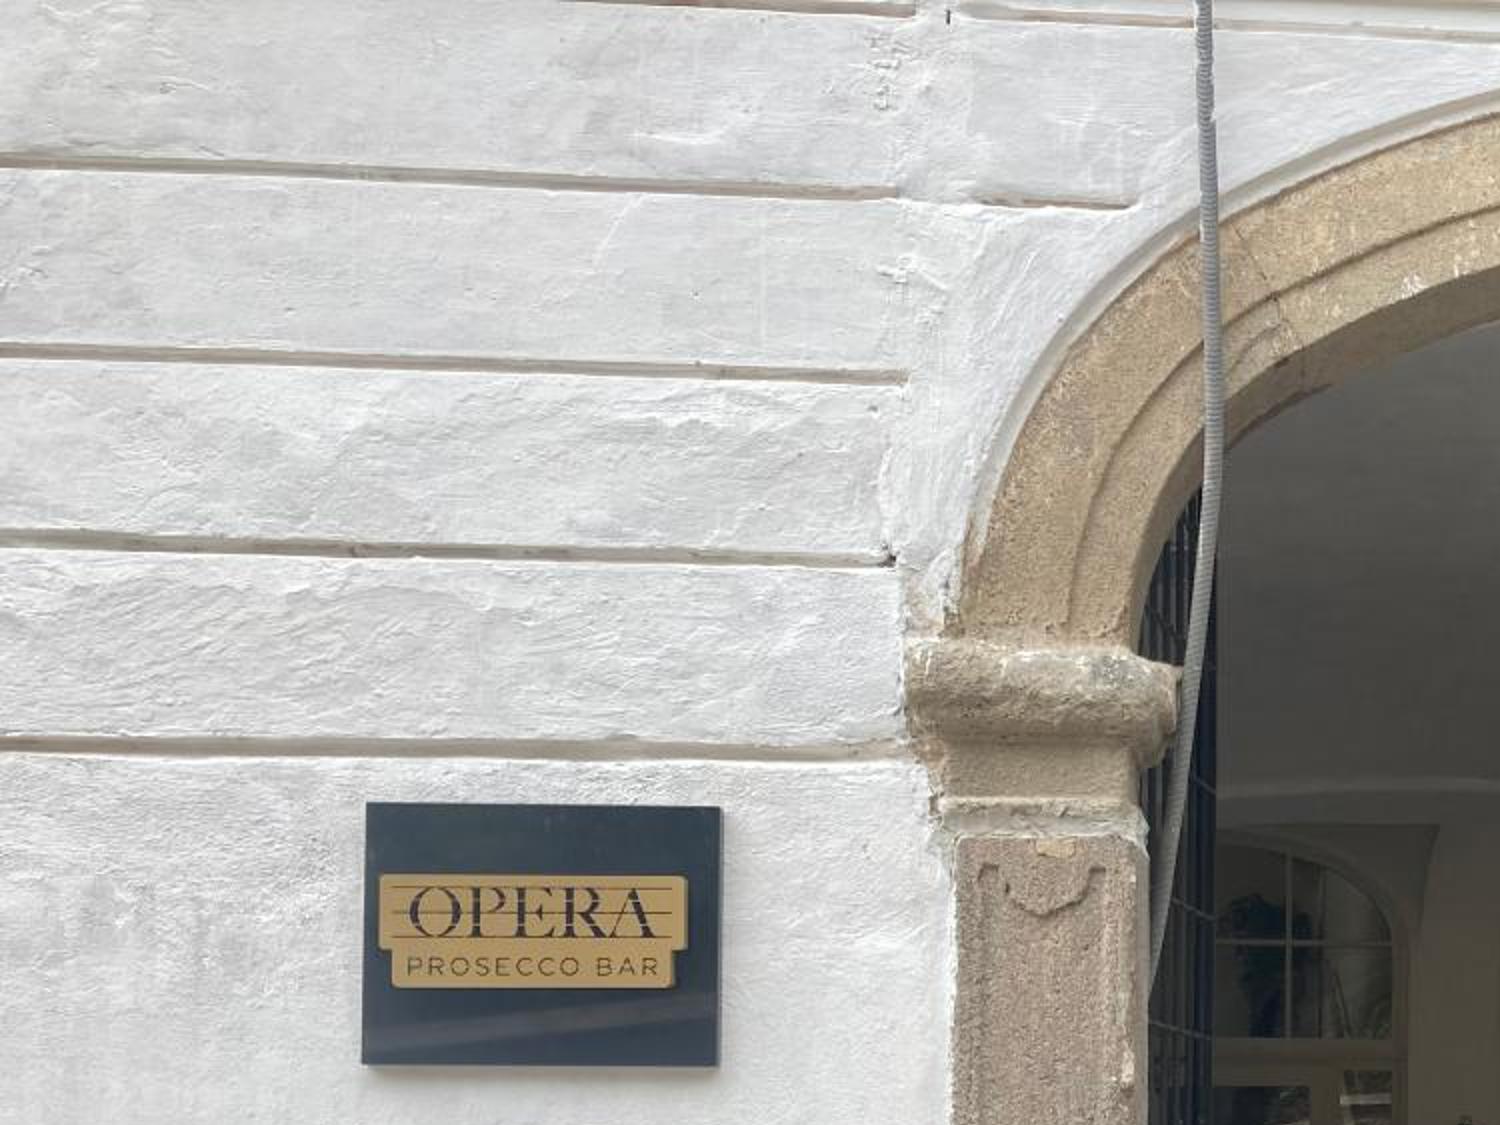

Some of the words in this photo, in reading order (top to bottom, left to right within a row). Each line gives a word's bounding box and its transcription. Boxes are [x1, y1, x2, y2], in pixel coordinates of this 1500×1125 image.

[408, 886, 657, 938] OPERA
[407, 956, 580, 978] PROSECCO
[596, 957, 658, 977] BAR
